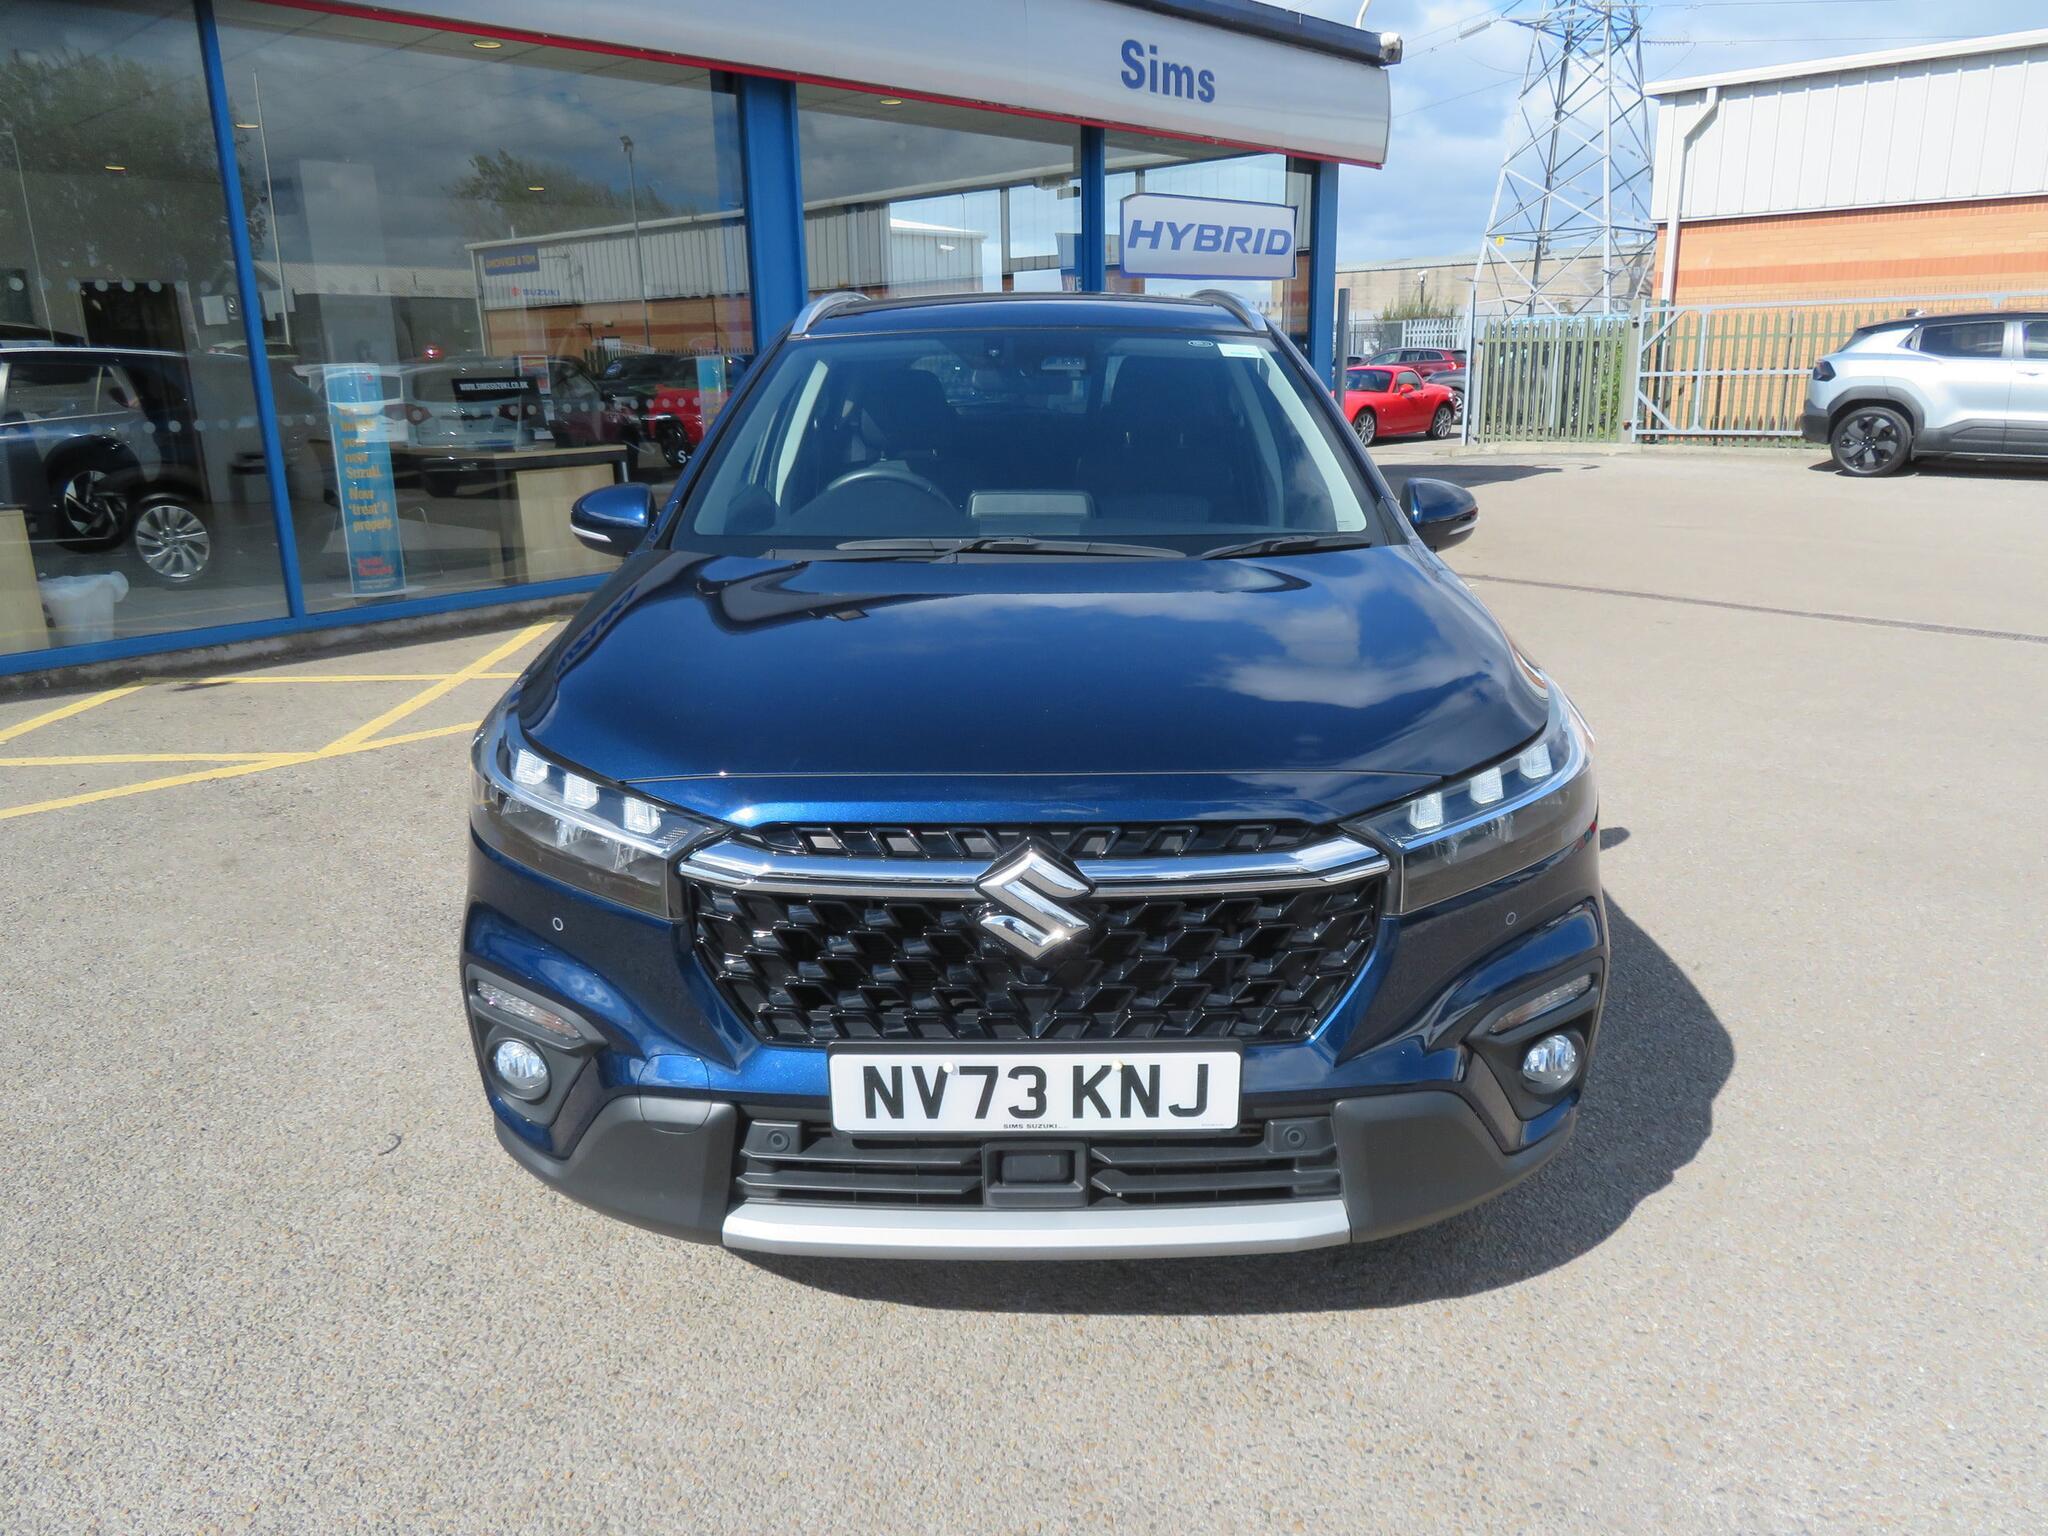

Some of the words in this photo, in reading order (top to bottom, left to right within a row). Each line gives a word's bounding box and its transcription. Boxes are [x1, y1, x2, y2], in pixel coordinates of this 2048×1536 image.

[1121, 40, 1216, 103] Sims
[1128, 219, 1293, 257] HYBRID
[862, 1064, 1047, 1120] NV73
[1072, 1063, 1209, 1119] KNJ
